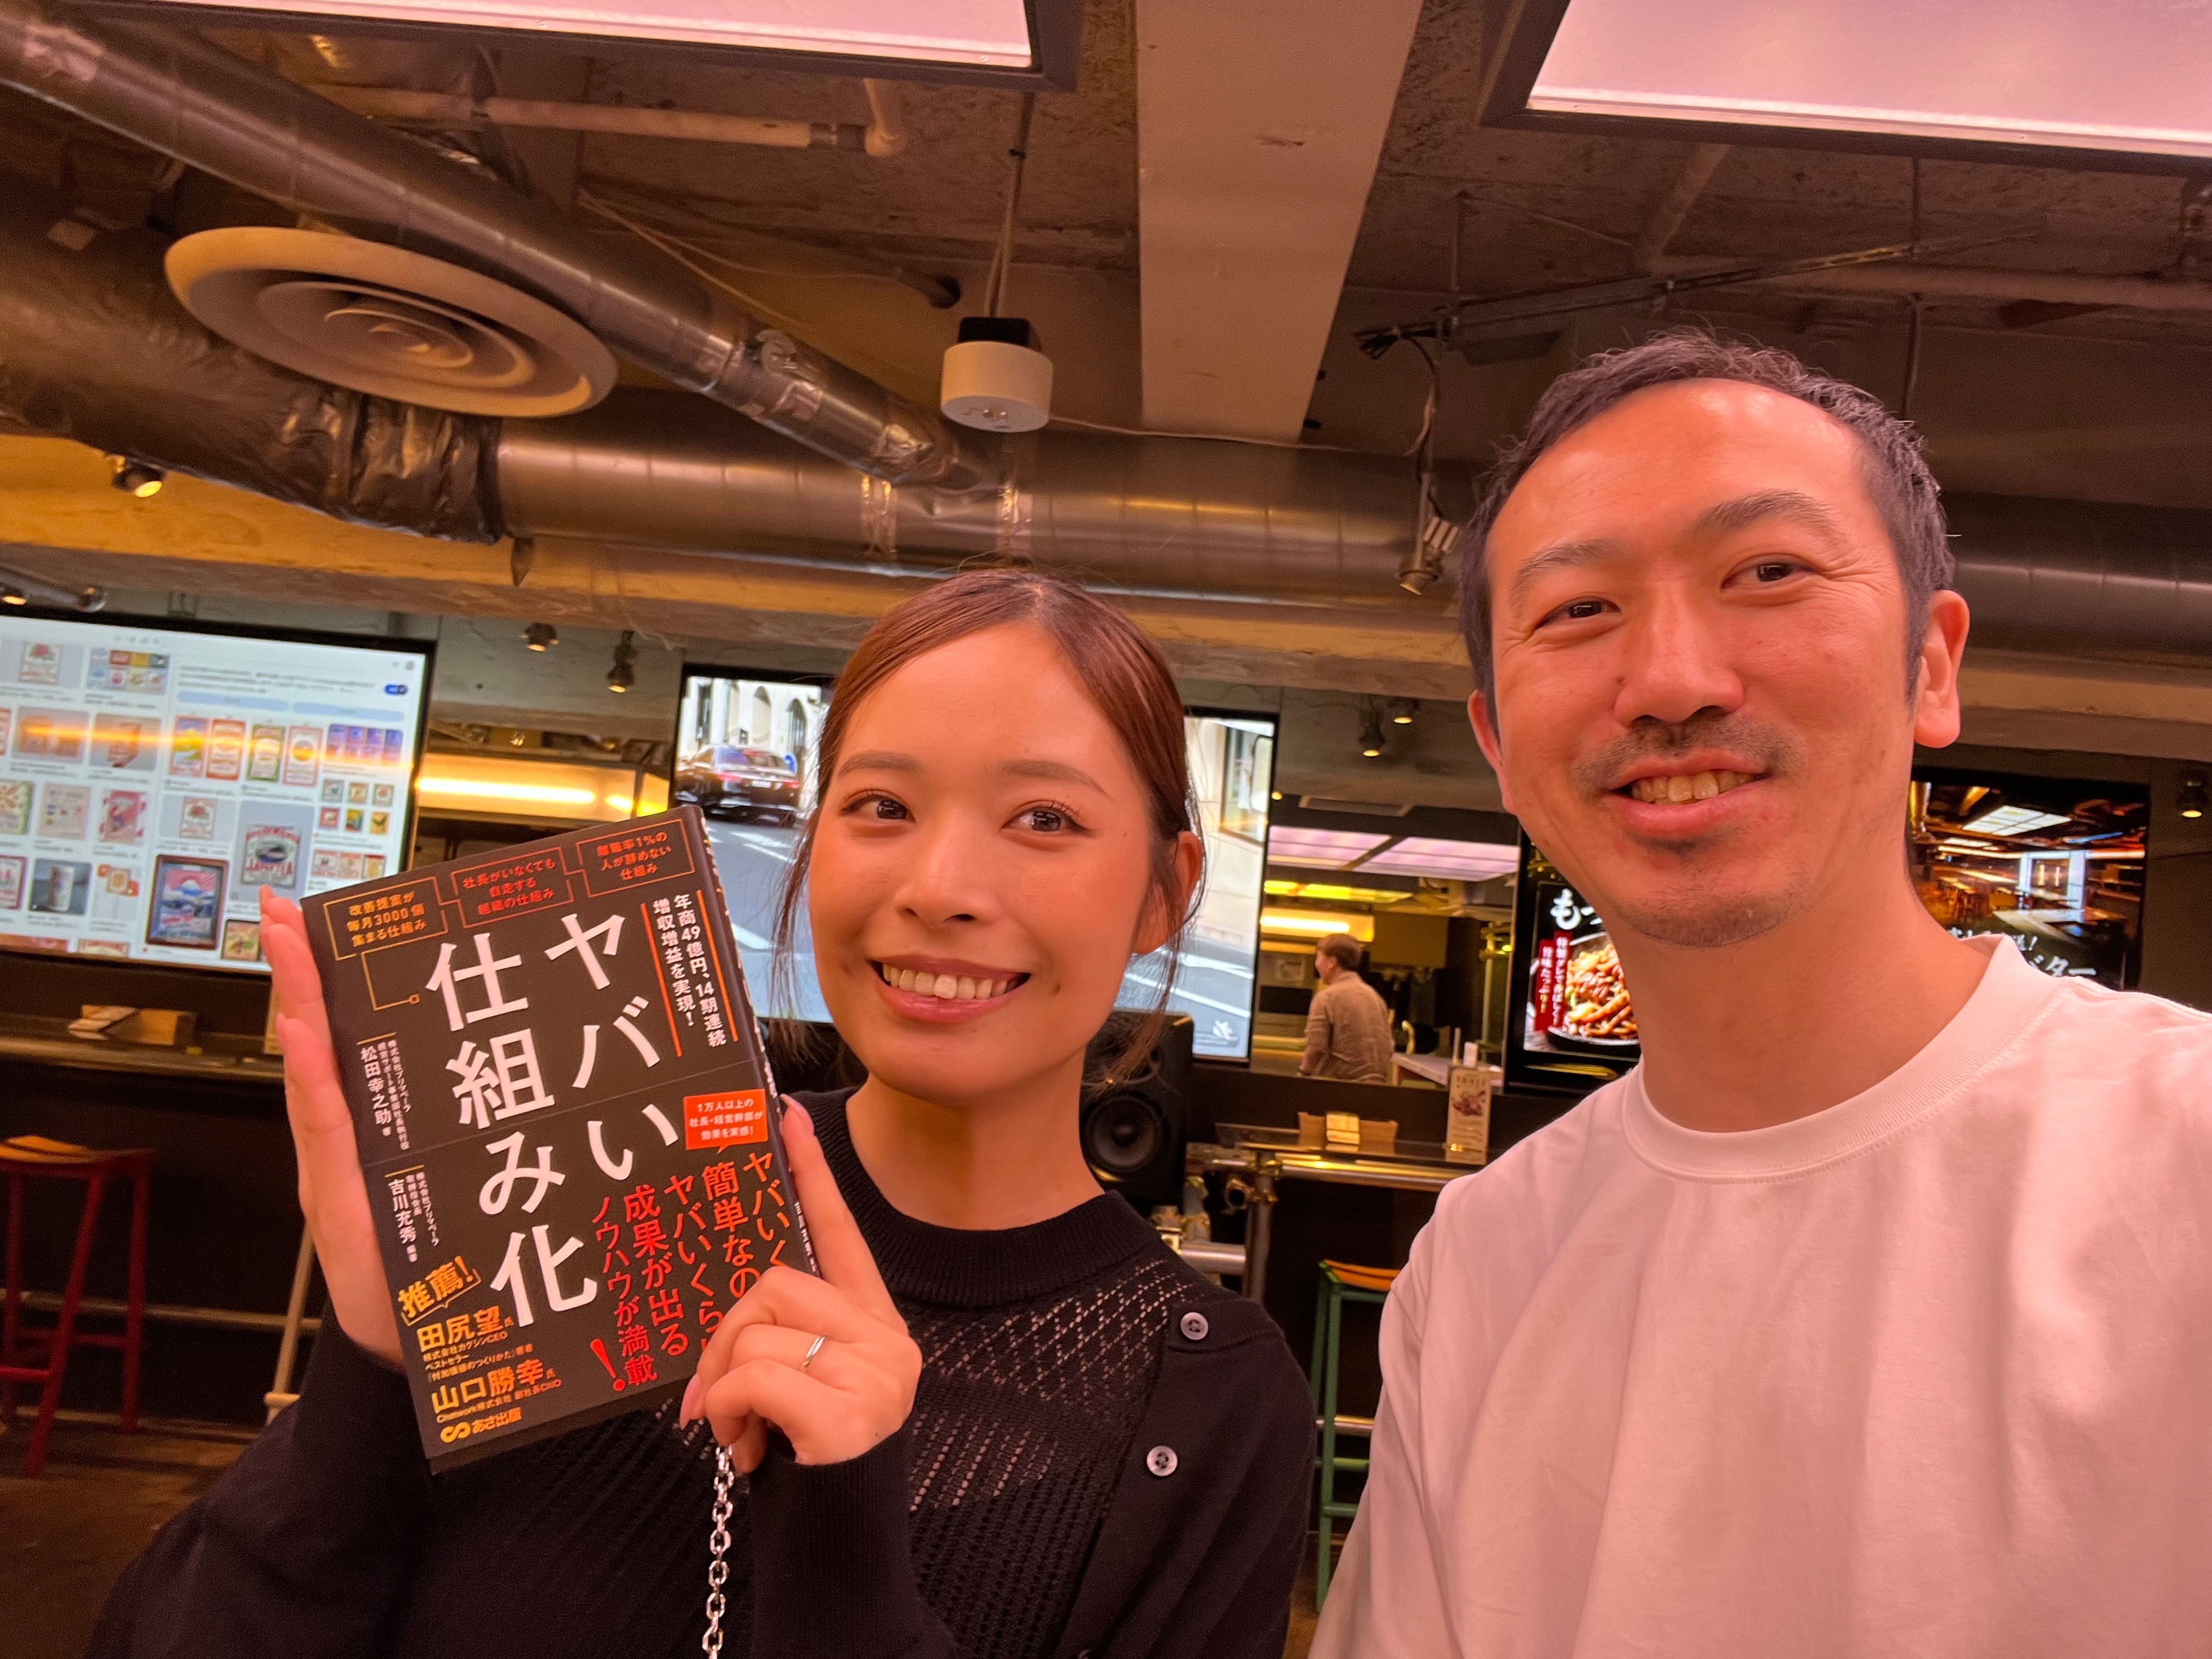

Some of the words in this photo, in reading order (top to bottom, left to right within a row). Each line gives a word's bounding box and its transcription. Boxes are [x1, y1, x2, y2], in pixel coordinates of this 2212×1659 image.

[620, 863, 658, 881] 仕組み
[545, 913, 678, 1181] ヤバい
[674, 894, 727, 1048] 年商49億円、14期連続
[426, 933, 598, 1327] 仕組み化
[697, 1098, 754, 1113] 1万人以上の
[623, 1184, 690, 1356] 成果が出る
[664, 1175, 725, 1351] ヤバいくら
[472, 1407, 522, 1435] あさ出版
